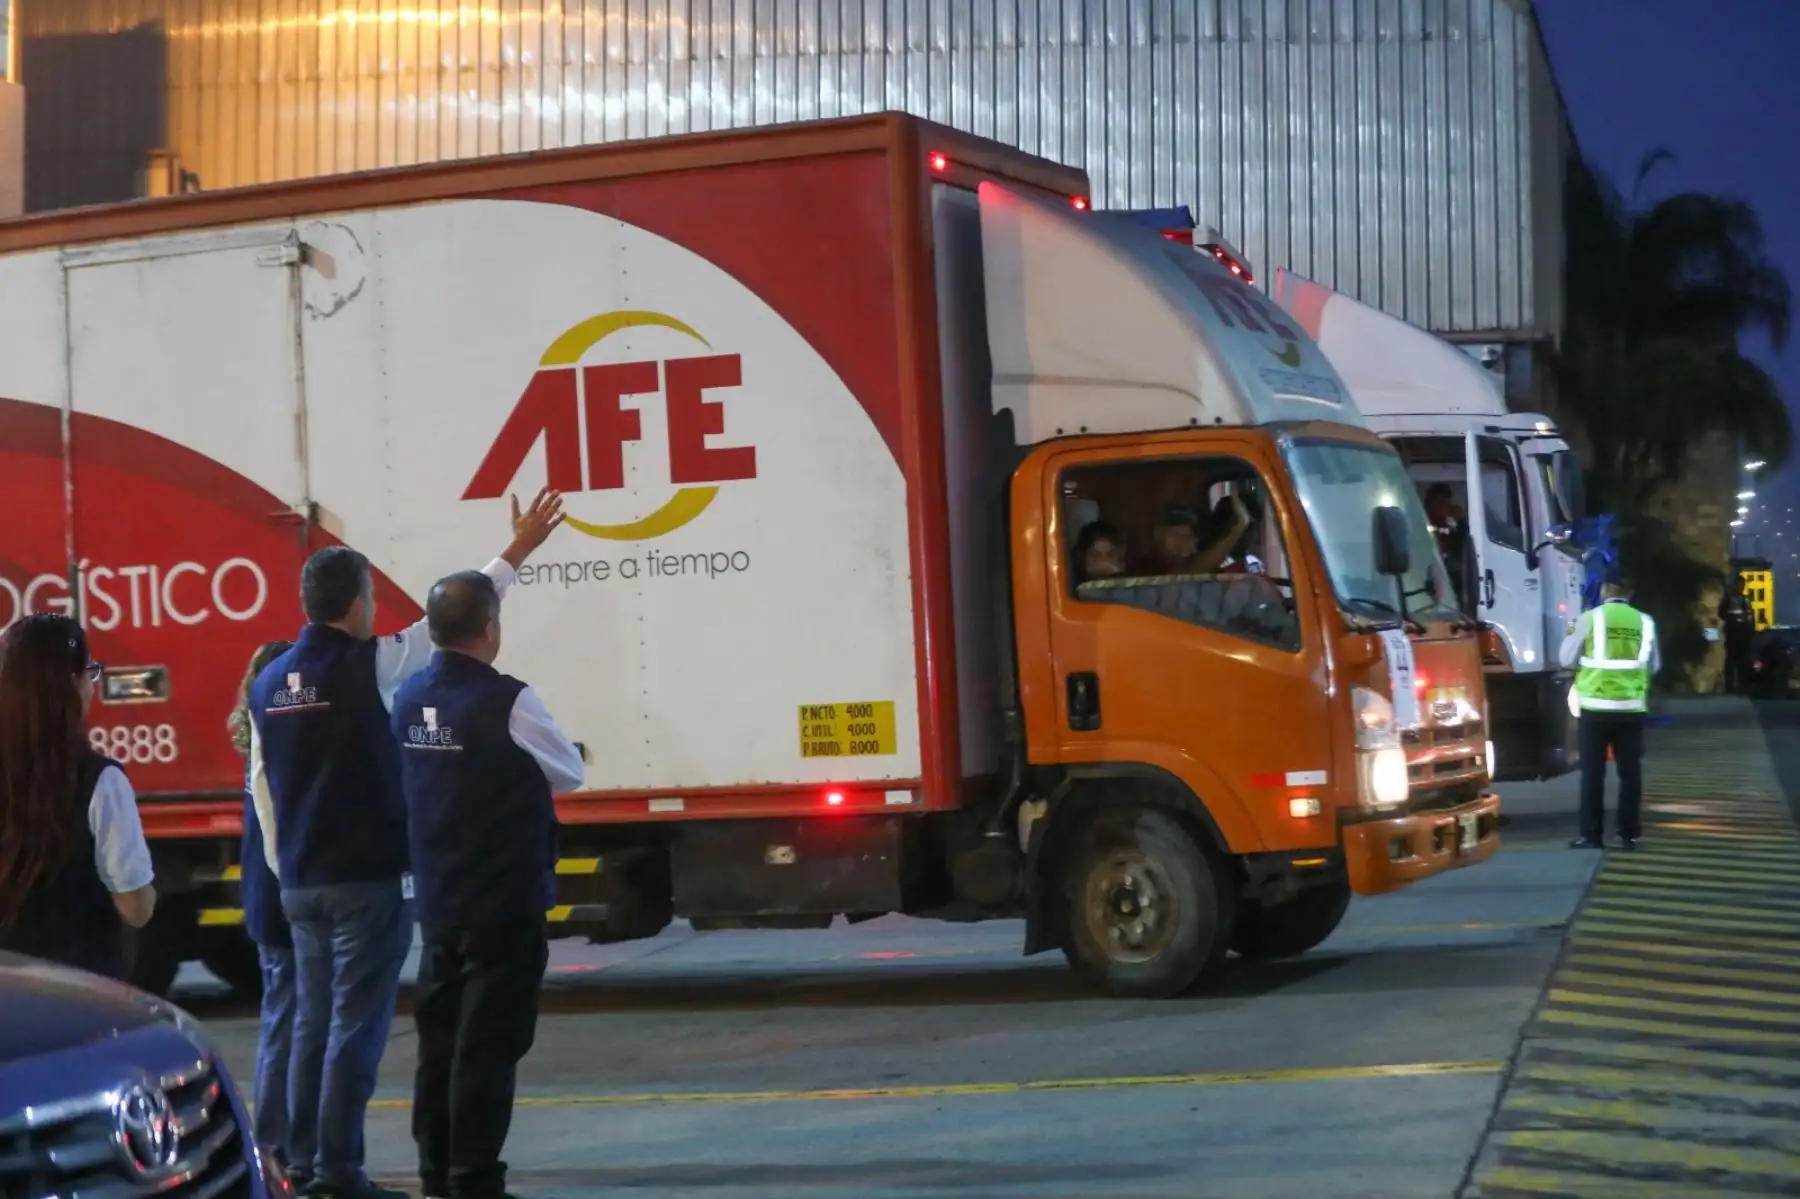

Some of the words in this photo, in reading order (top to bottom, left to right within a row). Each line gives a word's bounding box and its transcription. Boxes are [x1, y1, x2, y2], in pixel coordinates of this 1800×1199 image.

[460, 353, 757, 500] AFE
[513, 558, 610, 589] empre
[619, 558, 638, 579] a
[646, 549, 750, 579] tiempo
[273, 686, 317, 706] ONPE
[88, 724, 179, 764] 8888
[408, 724, 453, 744] ONPE
